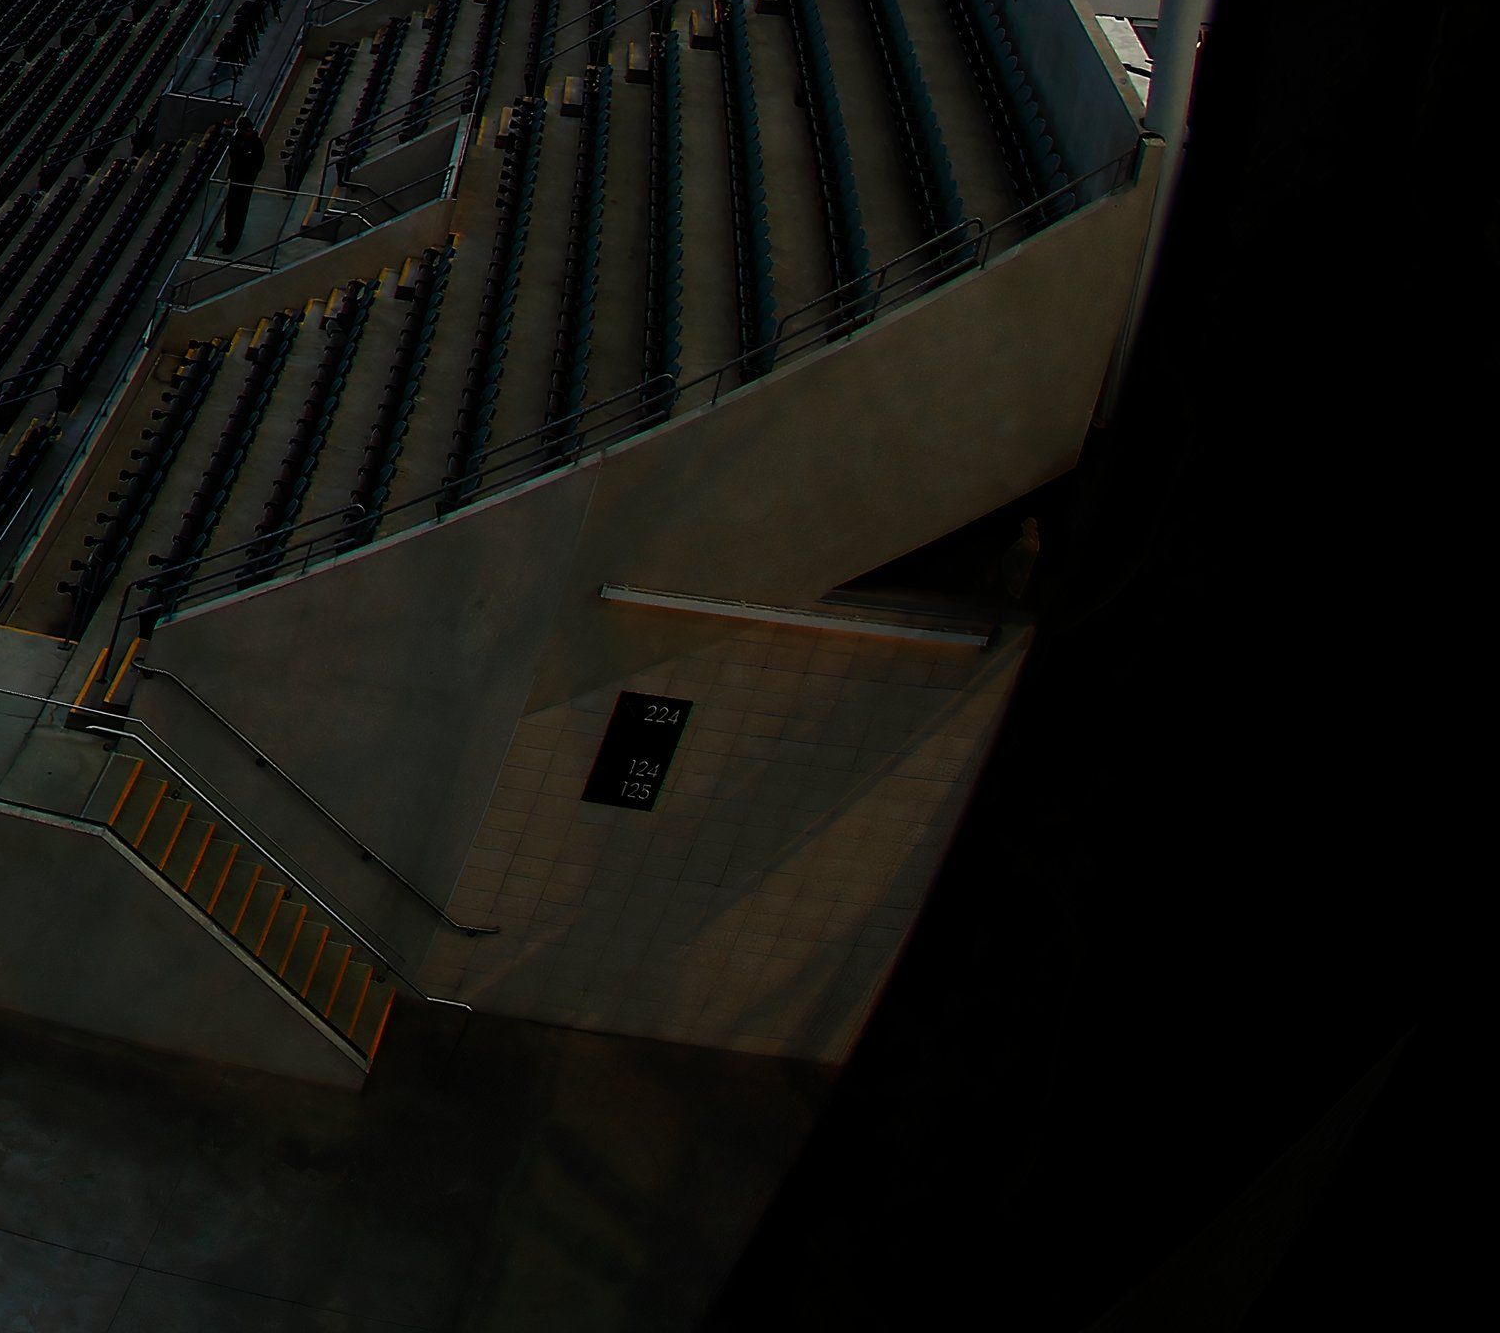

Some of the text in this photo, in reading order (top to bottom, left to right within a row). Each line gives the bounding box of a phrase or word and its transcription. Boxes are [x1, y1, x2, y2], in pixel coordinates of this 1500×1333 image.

[644, 705, 680, 725] 224
[629, 759, 660, 778] 124
[620, 781, 652, 800] 125
